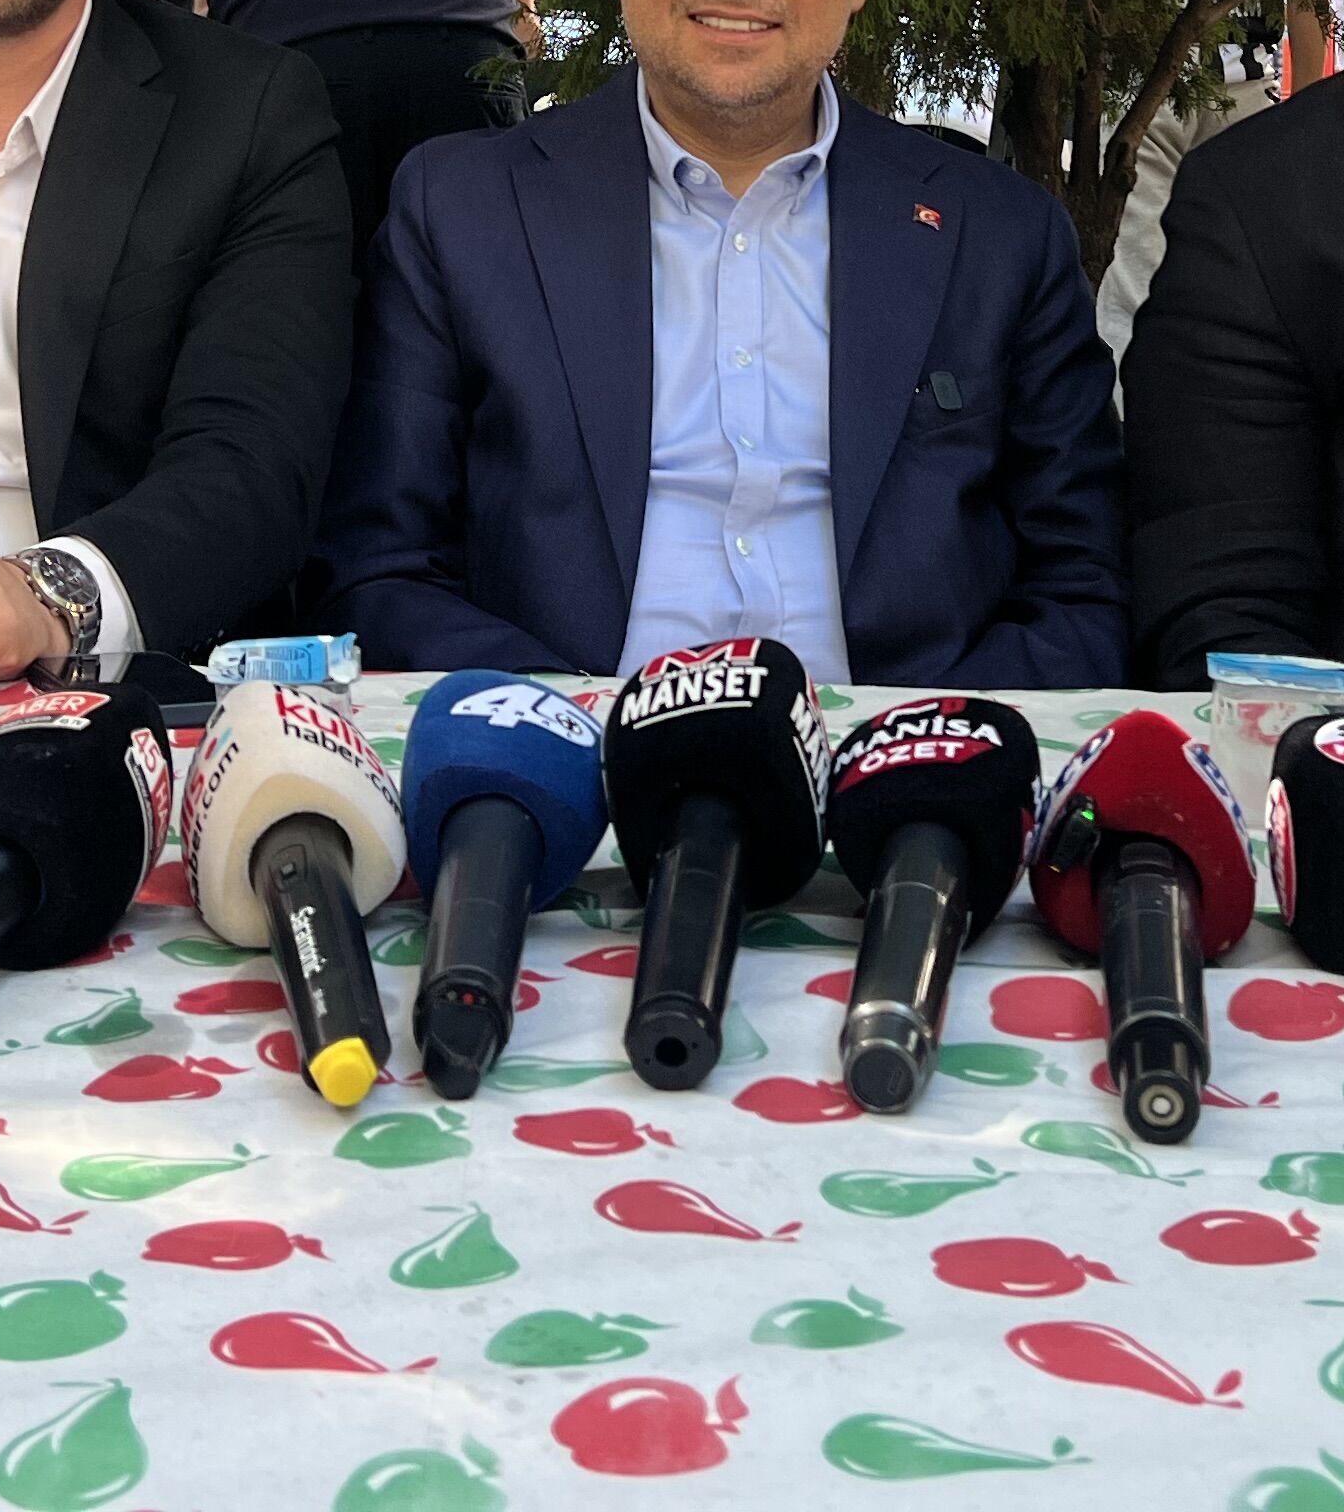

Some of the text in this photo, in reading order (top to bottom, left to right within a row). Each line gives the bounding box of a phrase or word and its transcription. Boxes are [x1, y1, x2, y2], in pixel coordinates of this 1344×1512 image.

[620, 666, 769, 727] MANŞET
[275, 690, 385, 777] kulis
[859, 740, 965, 774] ÖZET
